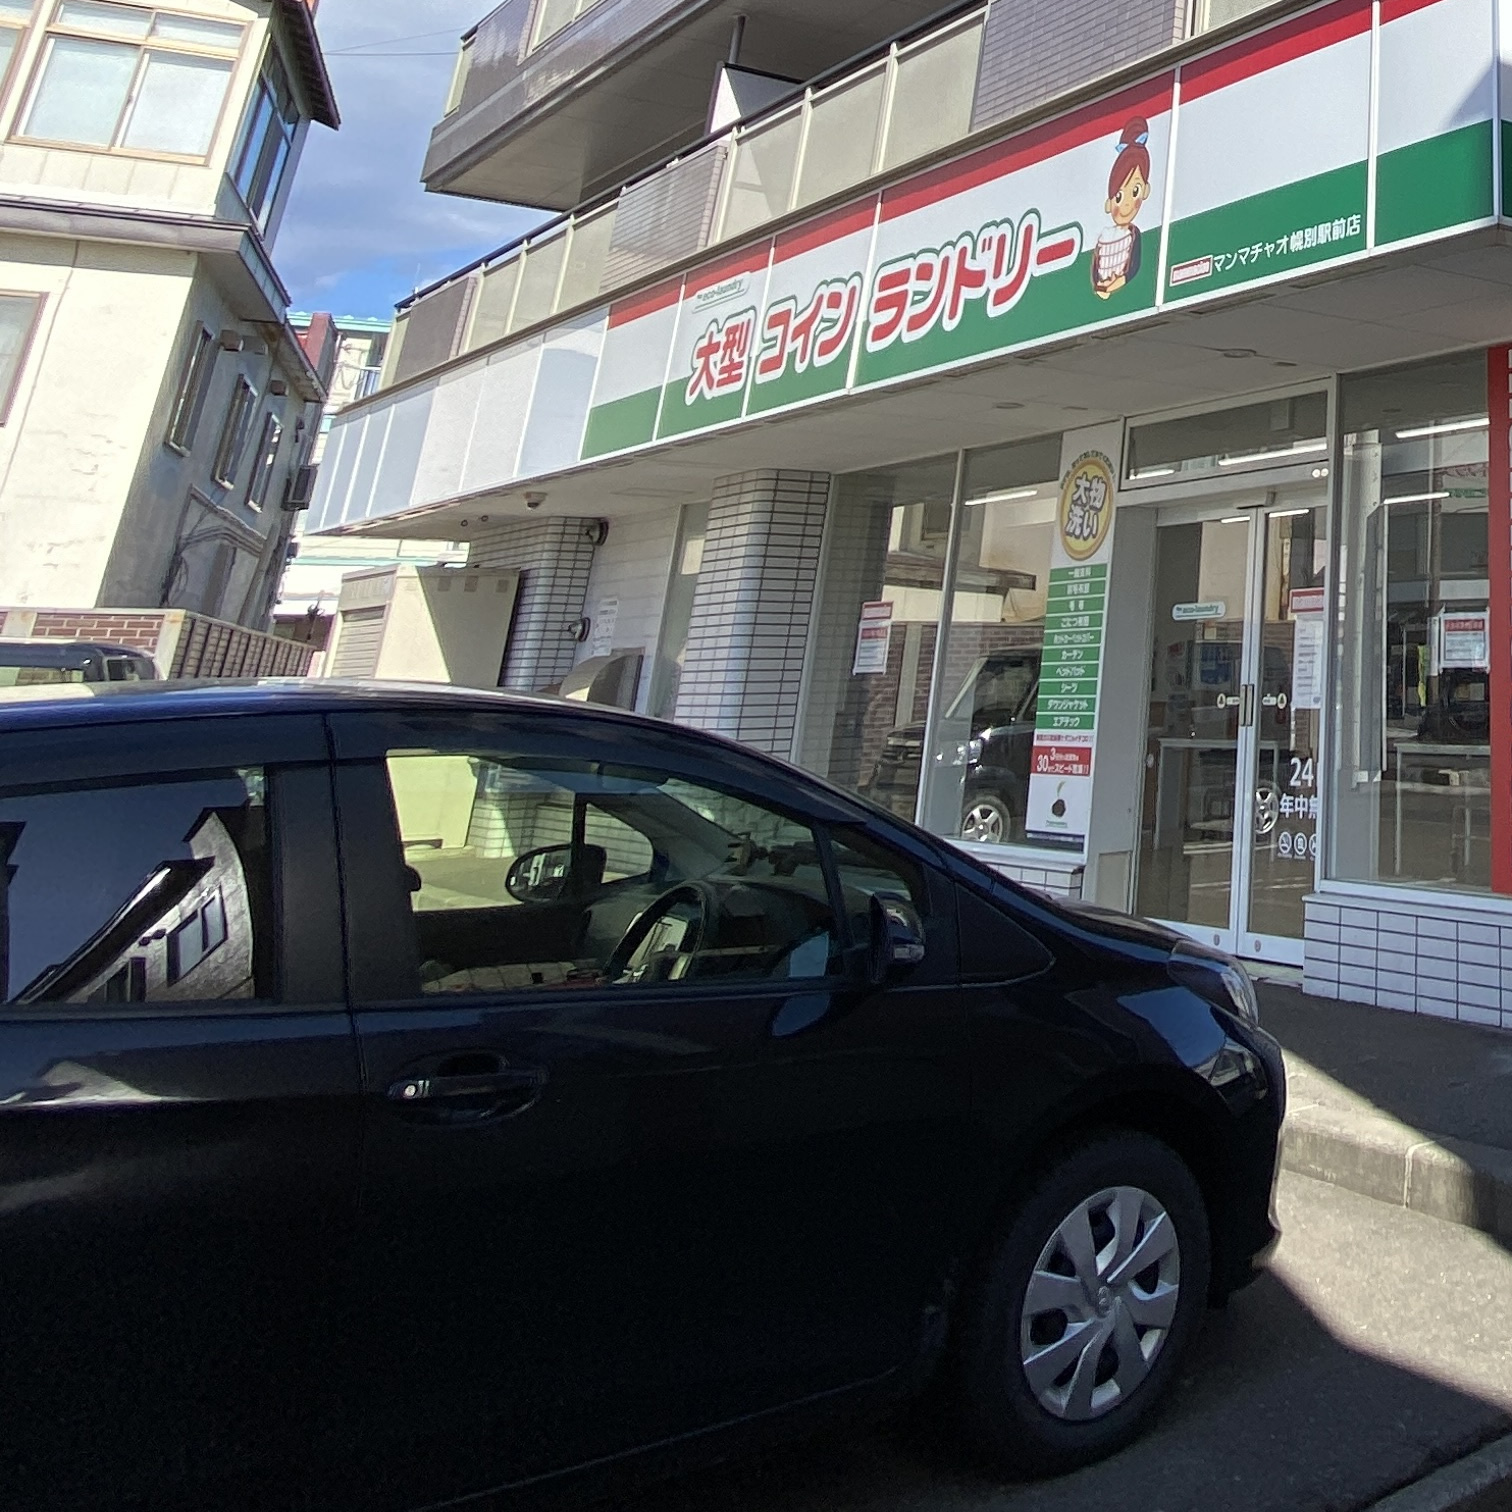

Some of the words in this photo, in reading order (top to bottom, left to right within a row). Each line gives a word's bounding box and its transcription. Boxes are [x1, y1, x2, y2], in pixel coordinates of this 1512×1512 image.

[1213, 214, 1362, 273] マンマチャオ幌別駅前店
[687, 312, 755, 402] 大型
[756, 276, 861, 381] コイン
[868, 214, 1081, 349] ランドリー
[1289, 757, 1315, 788] 24
